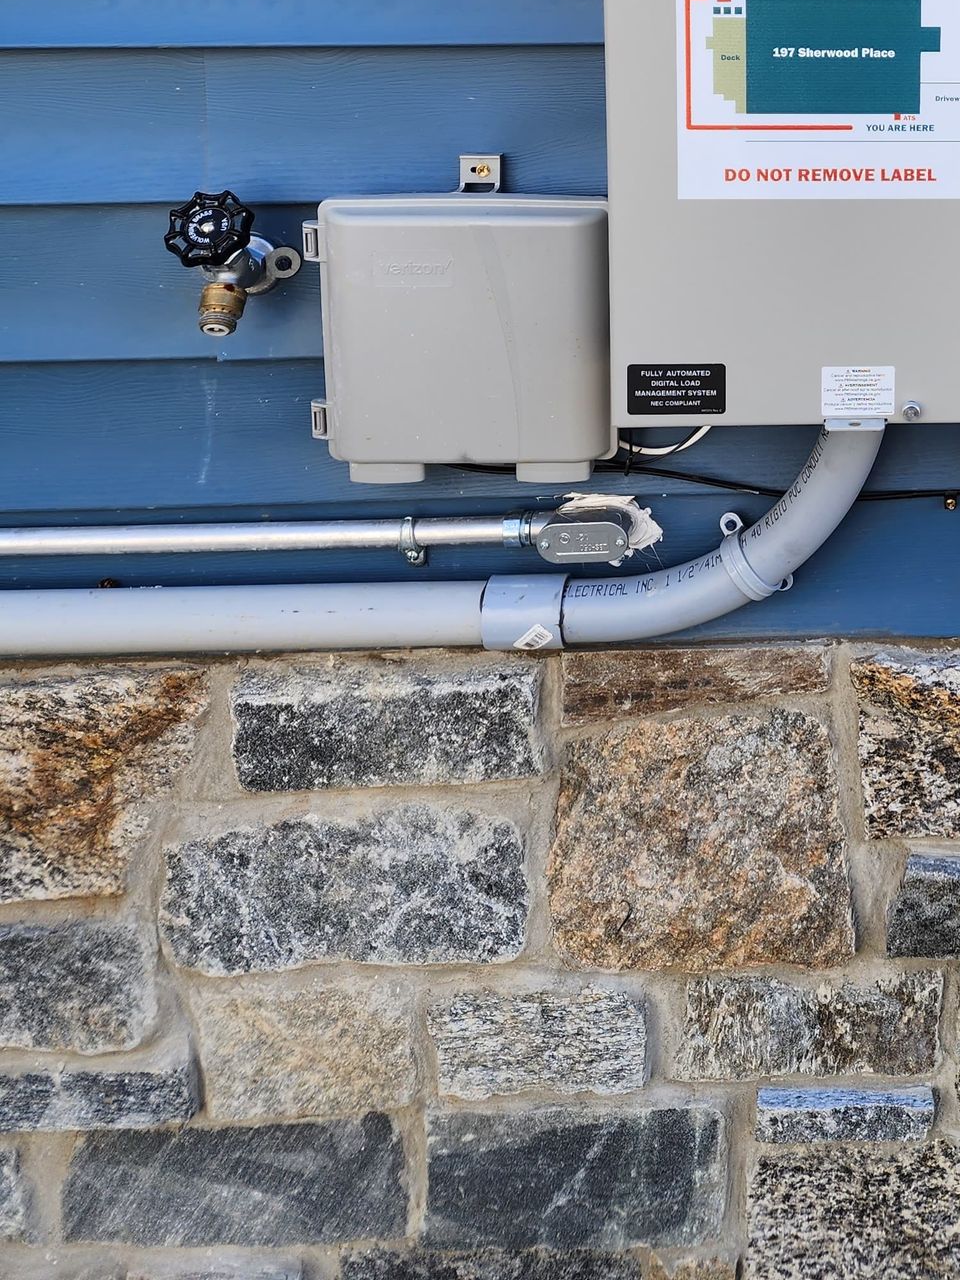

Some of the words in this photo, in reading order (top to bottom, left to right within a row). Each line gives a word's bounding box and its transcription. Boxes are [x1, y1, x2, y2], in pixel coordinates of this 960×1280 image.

[772, 47, 796, 58] 197
[797, 47, 859, 58] Sherwood
[861, 47, 896, 58] Place
[866, 124, 885, 132] YOU
[887, 124, 907, 132] ARE
[909, 124, 935, 132] HERE
[724, 168, 751, 182] DO
[756, 168, 793, 182] NOT
[798, 168, 876, 182] REMOVE
[880, 168, 937, 182] LABEL
[220, 217, 228, 231] USA
[751, 524, 762, 539] 40
[764, 499, 788, 530] RIGID
[801, 440, 824, 484] CONDUIT
[665, 573, 670, 587] 1
